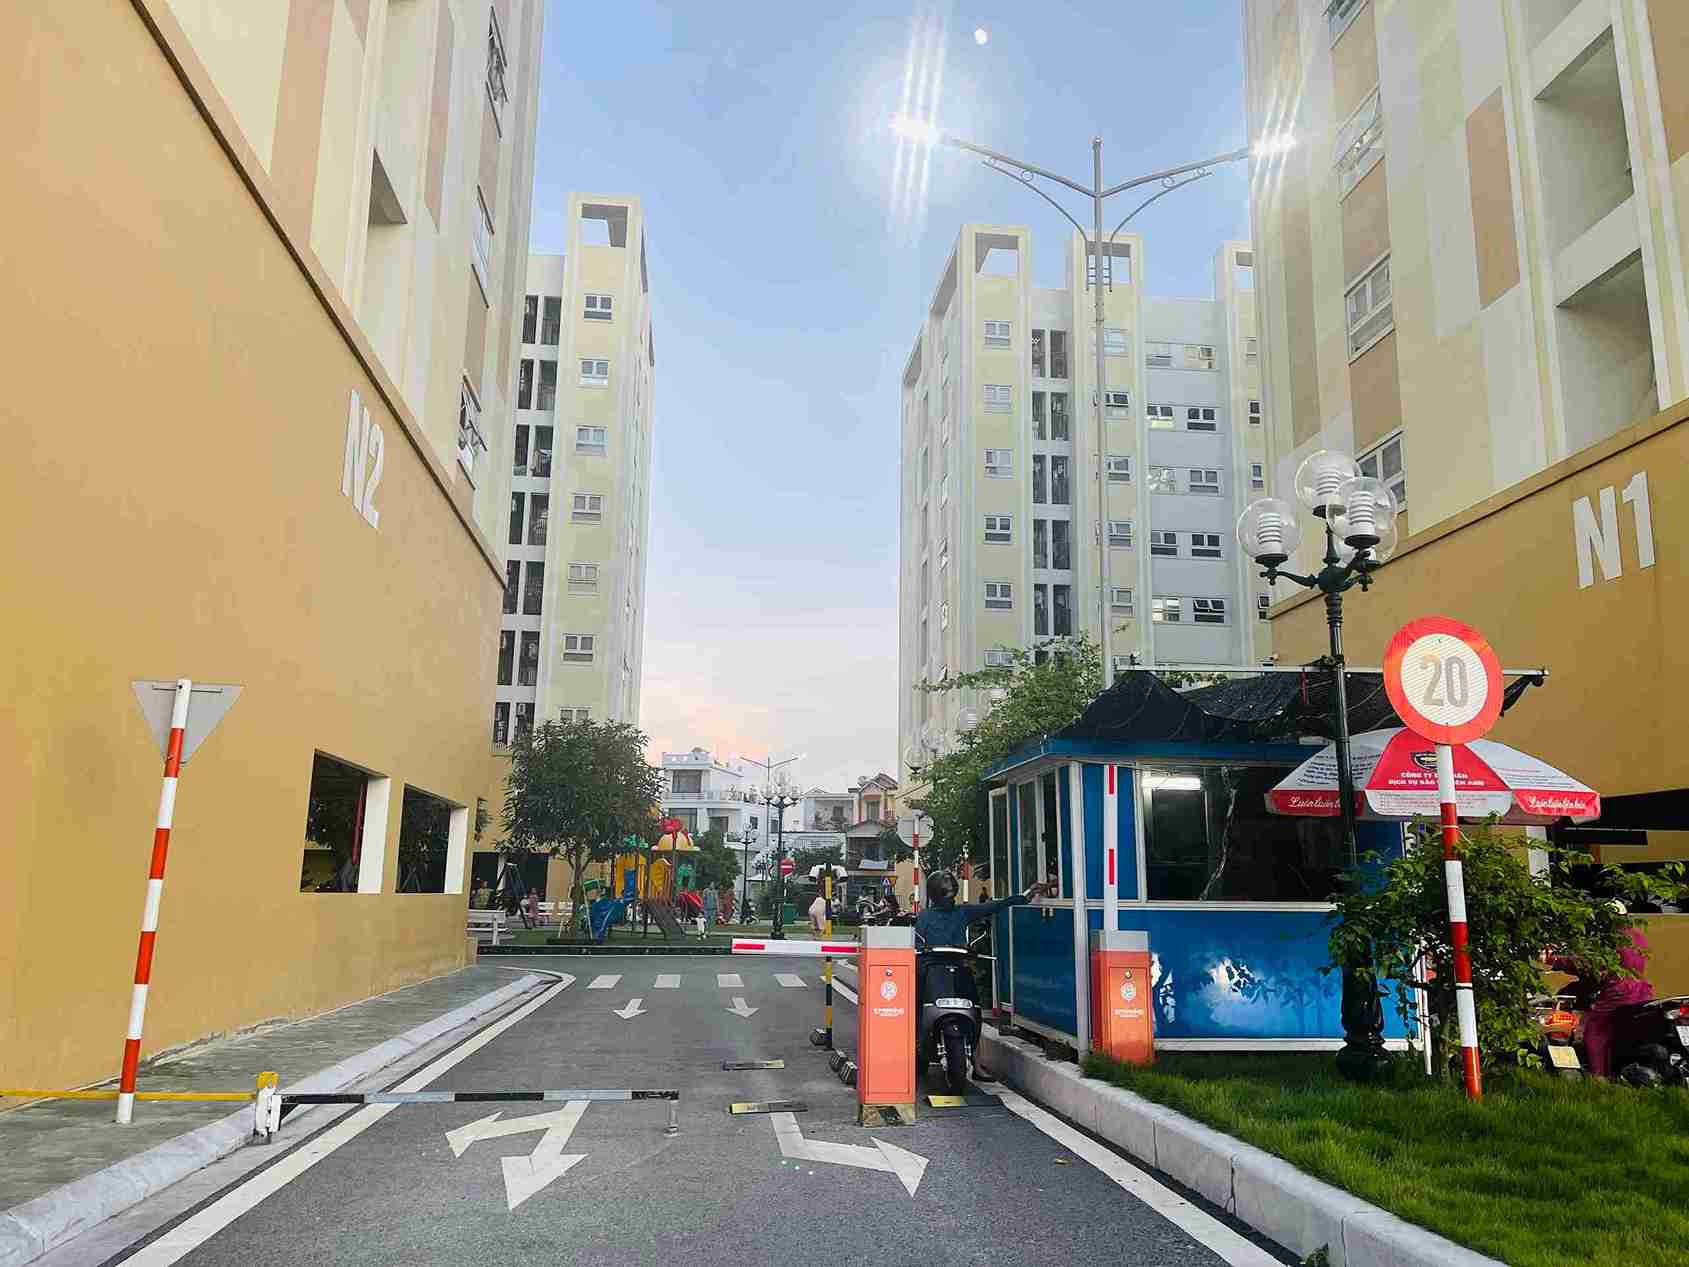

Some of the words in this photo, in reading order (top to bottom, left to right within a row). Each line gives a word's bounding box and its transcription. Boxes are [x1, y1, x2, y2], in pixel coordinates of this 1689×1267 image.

[341, 389, 384, 529] N2
[1573, 471, 1656, 589] N1
[1420, 653, 1469, 707] 20
